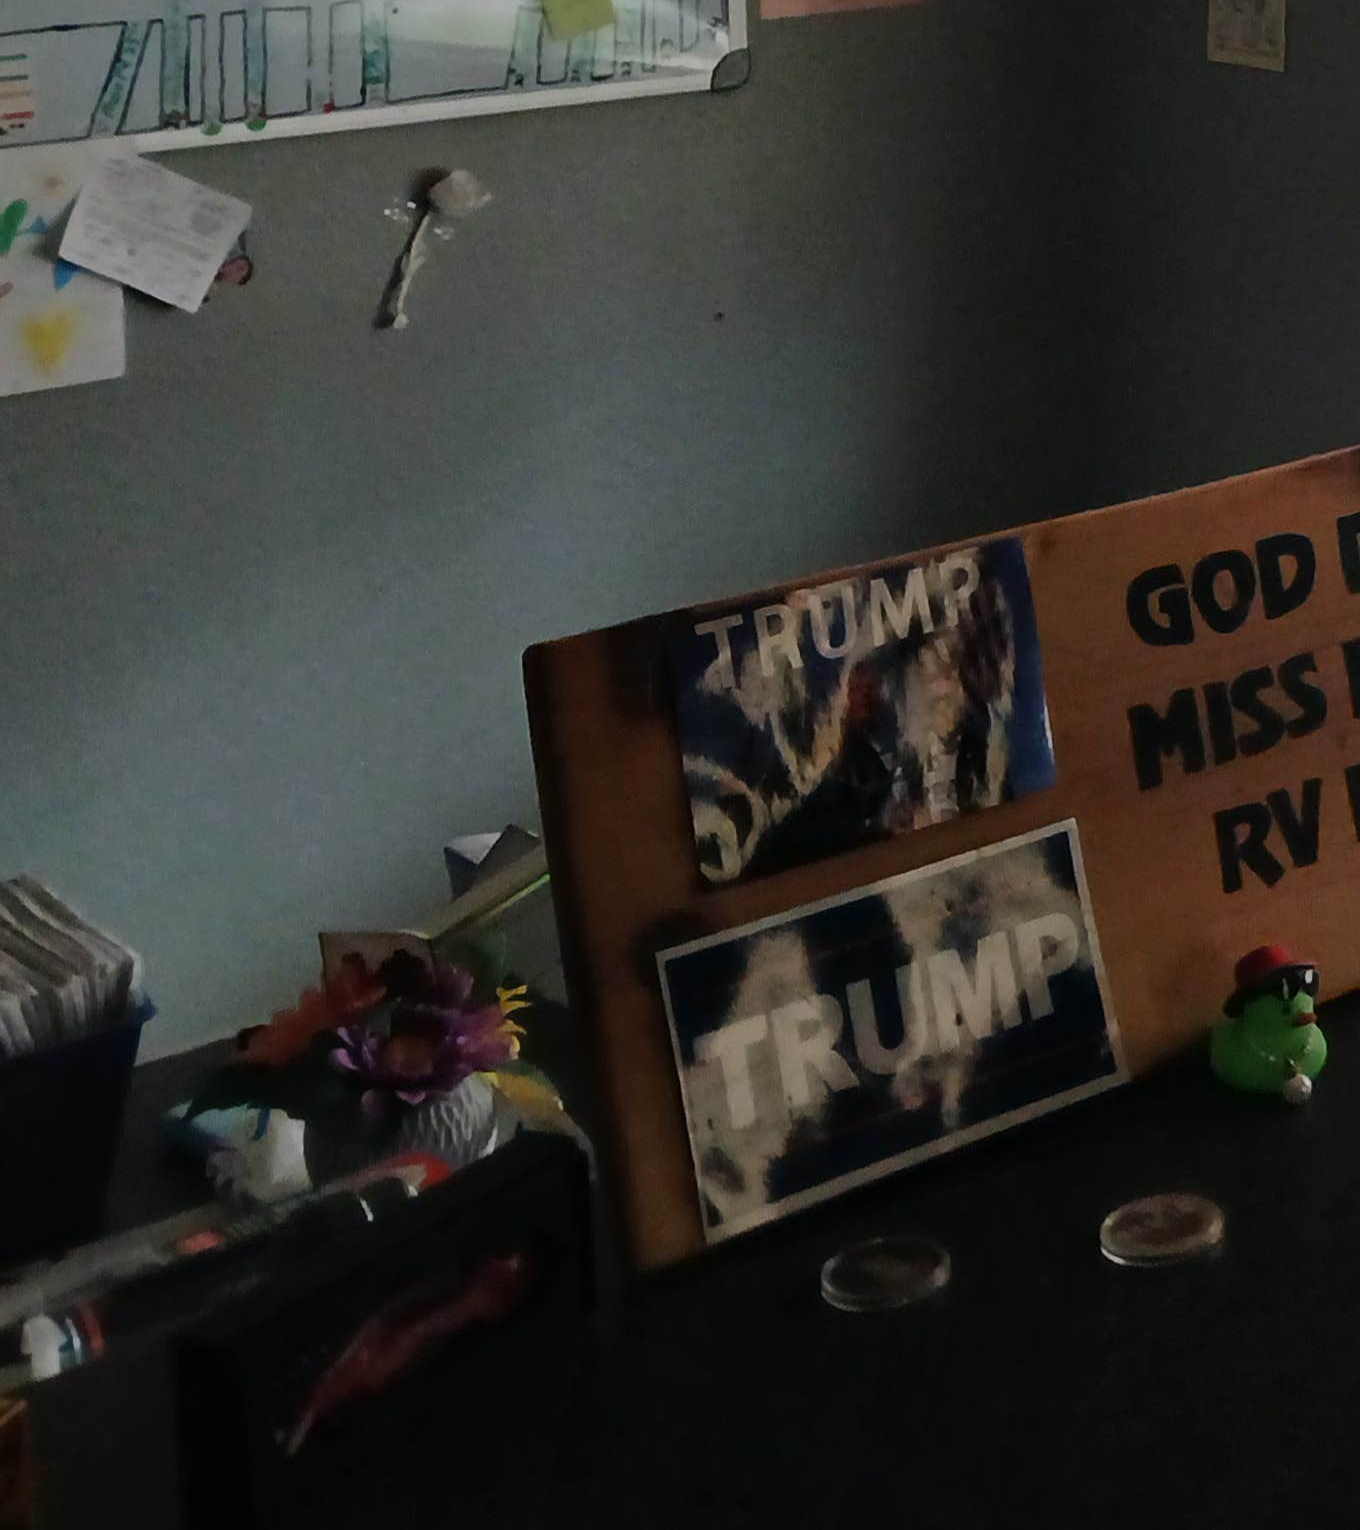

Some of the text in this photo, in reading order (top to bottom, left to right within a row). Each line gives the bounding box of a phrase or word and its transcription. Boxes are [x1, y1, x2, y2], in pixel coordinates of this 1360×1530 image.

[694, 553, 981, 690] TRUMP
[1126, 533, 1317, 646] GOD
[1126, 652, 1328, 791] MISS
[1212, 778, 1323, 894] RV
[693, 912, 1081, 1130] TRUMP
